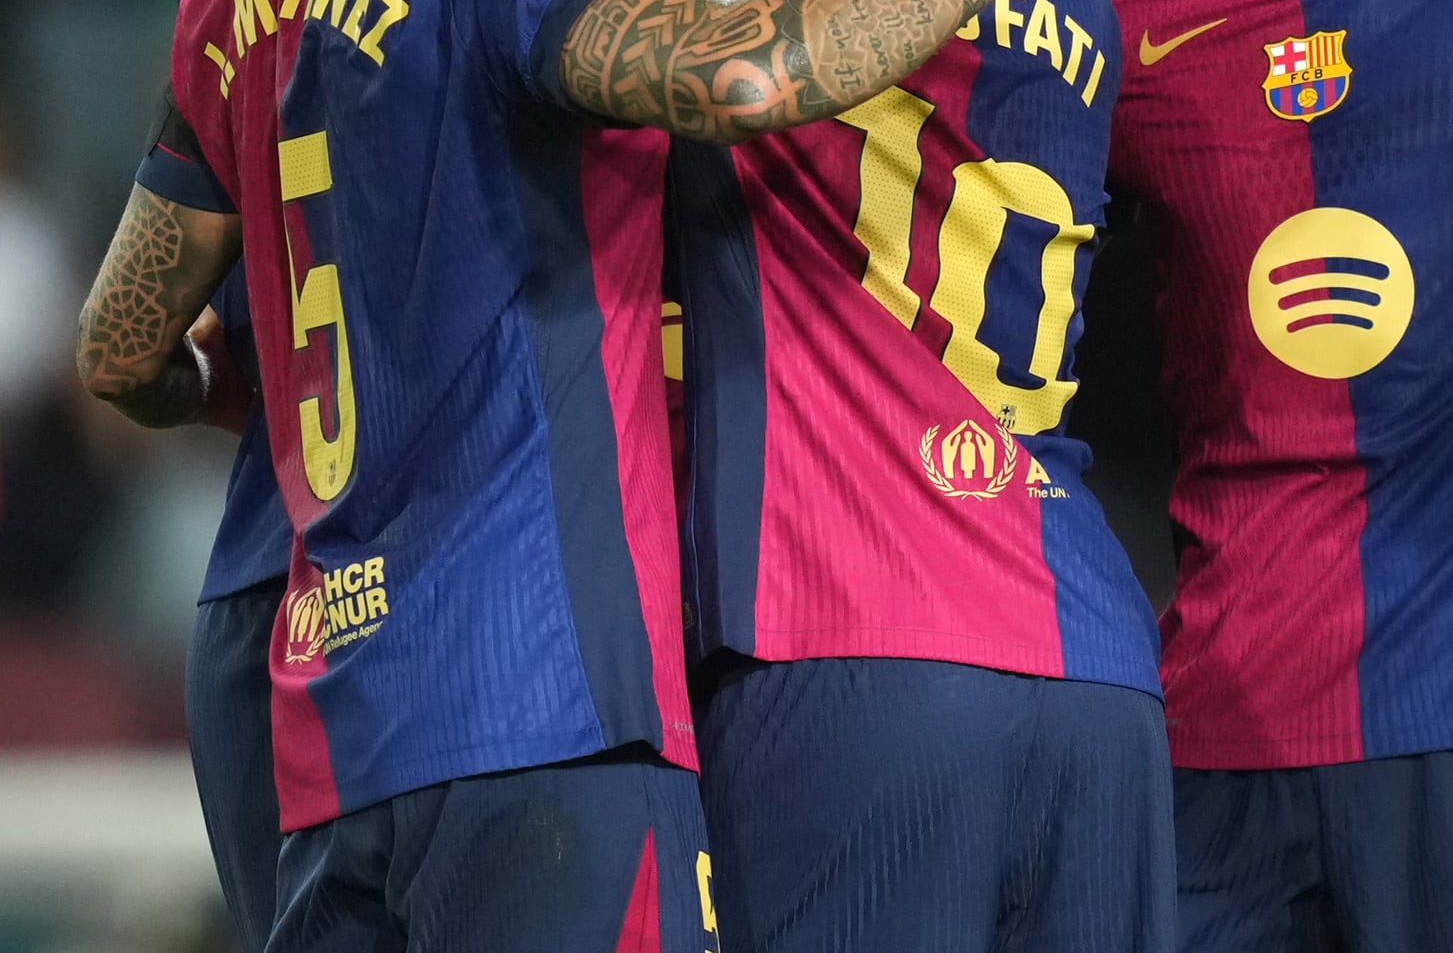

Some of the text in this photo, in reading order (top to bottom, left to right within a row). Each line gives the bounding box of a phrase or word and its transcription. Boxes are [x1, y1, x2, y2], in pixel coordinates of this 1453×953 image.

[277, 130, 357, 502] 5
[834, 85, 1096, 436] 10
[323, 556, 385, 603] HCR
[1027, 487, 1048, 499] The
